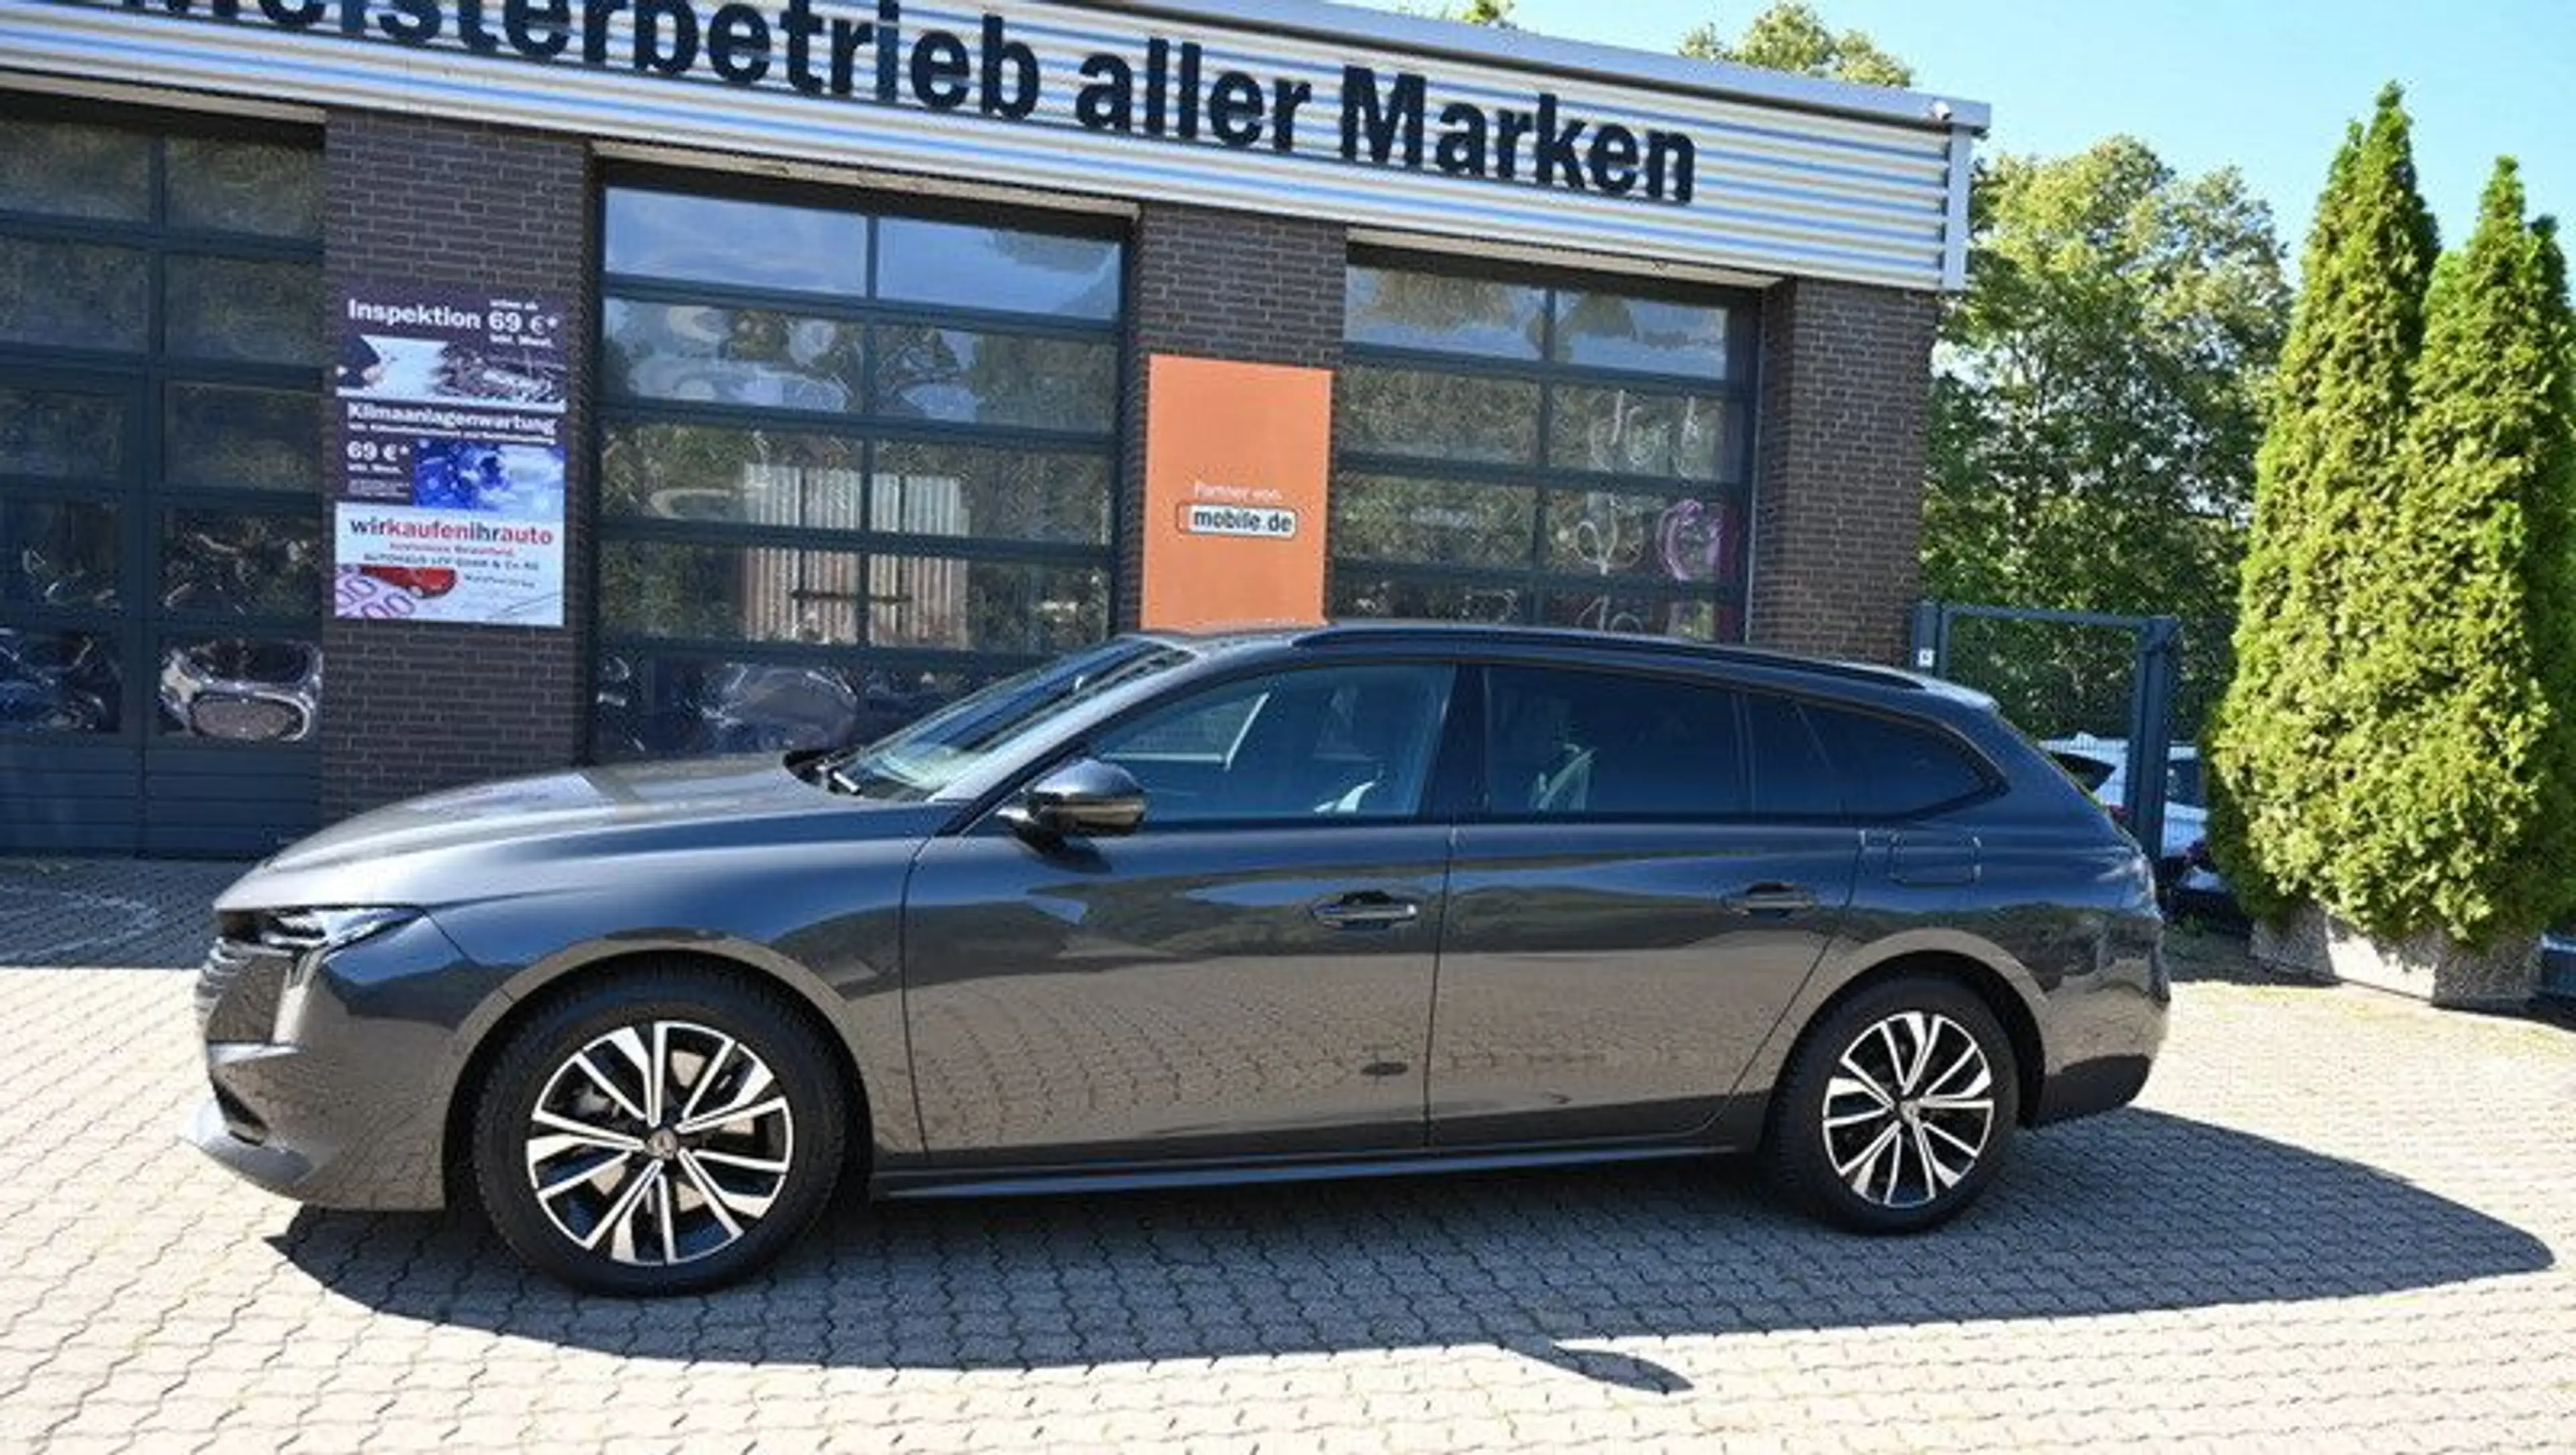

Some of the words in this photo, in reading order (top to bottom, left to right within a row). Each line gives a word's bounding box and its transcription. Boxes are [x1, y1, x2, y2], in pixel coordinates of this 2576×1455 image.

[123, 0, 1040, 119] sterbetrieb
[1077, 38, 1311, 152] aller
[1342, 64, 1696, 204] Marken
[347, 299, 481, 329] Inspektion
[488, 310, 522, 331] 69
[347, 401, 559, 436] Klimaanlagenwartung
[346, 441, 378, 461] 69
[350, 517, 555, 545] wirkaufenihrauto
[1193, 510, 1293, 532] mobile.de
